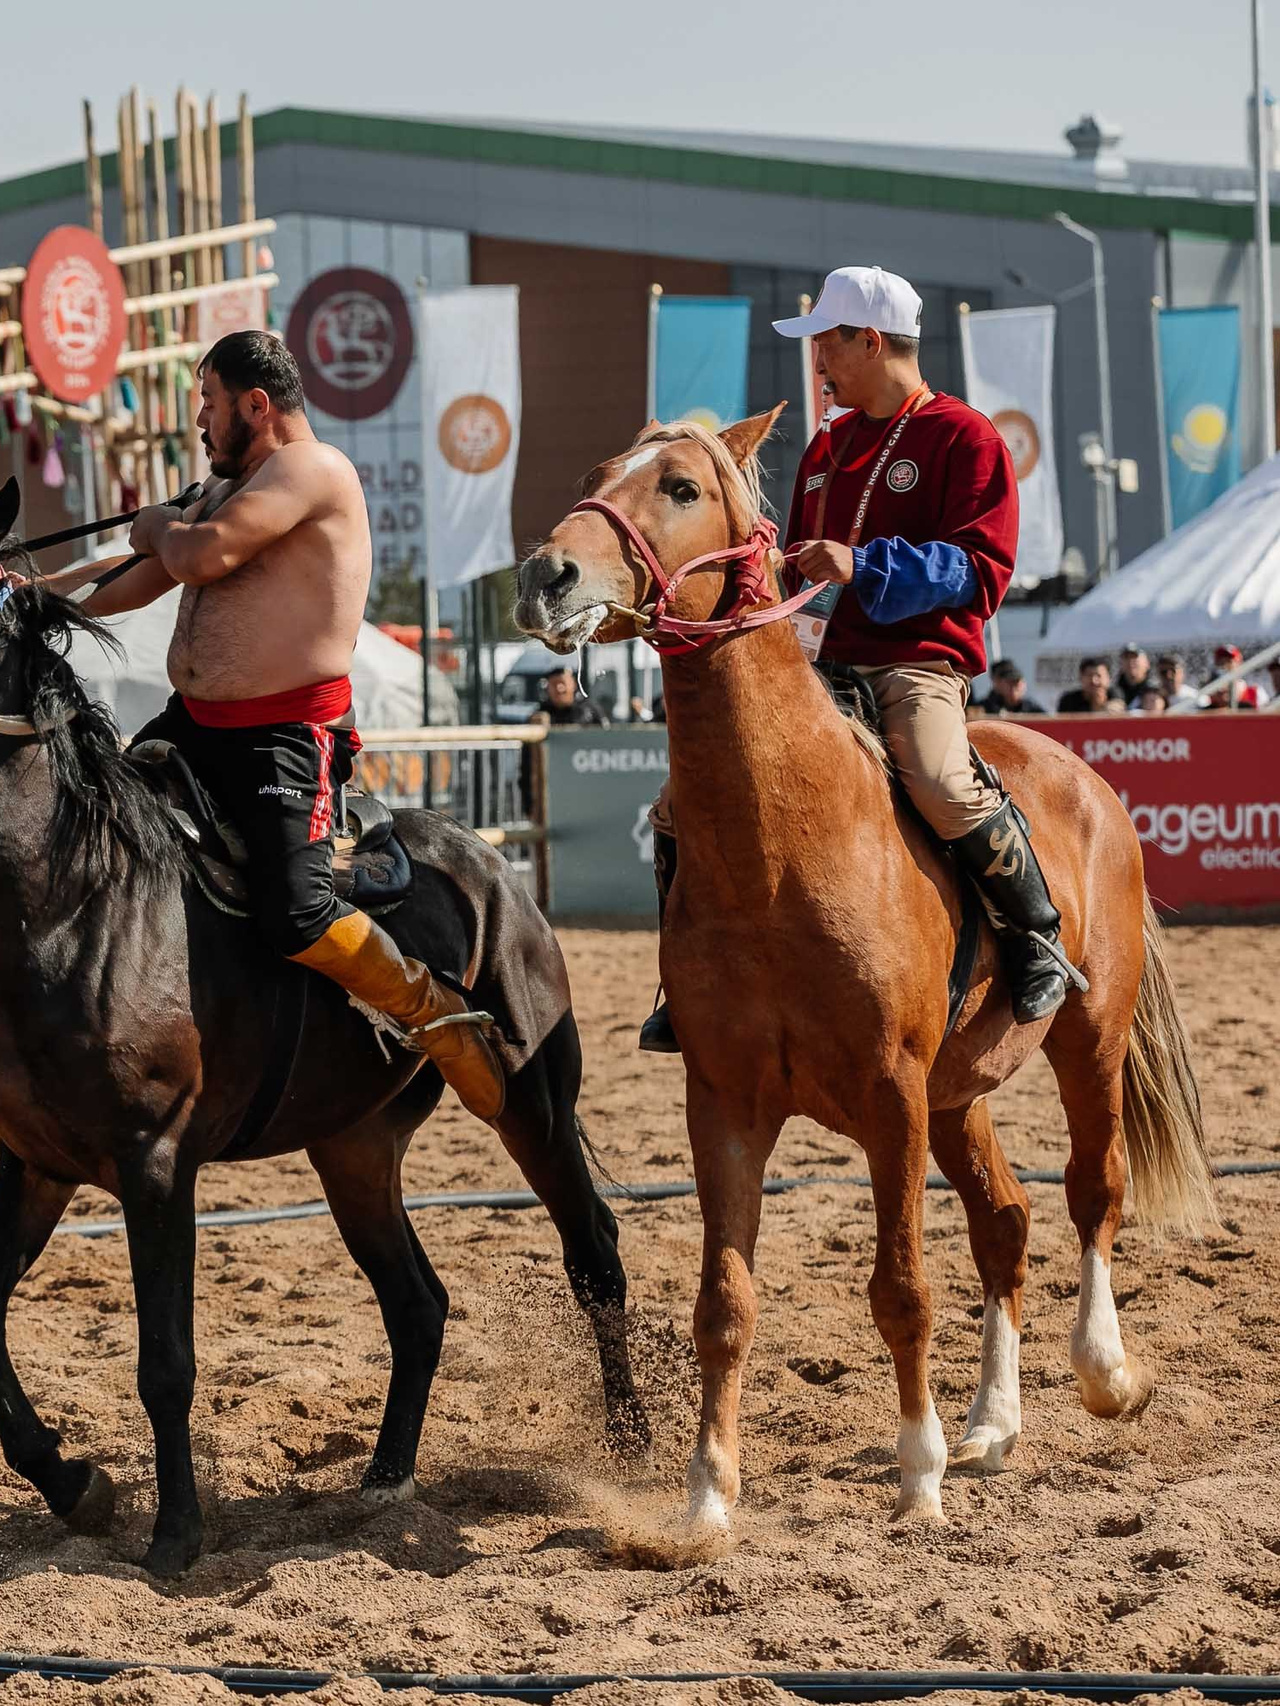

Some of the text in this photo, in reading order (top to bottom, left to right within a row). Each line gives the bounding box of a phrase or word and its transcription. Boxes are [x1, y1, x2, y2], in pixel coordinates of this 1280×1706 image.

[357, 461, 423, 492] RLD
[853, 489, 871, 528] WORLD
[868, 449, 890, 486] NOMAD
[572, 749, 670, 773] GENERAL
[1083, 738, 1190, 762] SPONSOR
[258, 785, 302, 799] uhlsport
[1120, 790, 1280, 854] ageum
